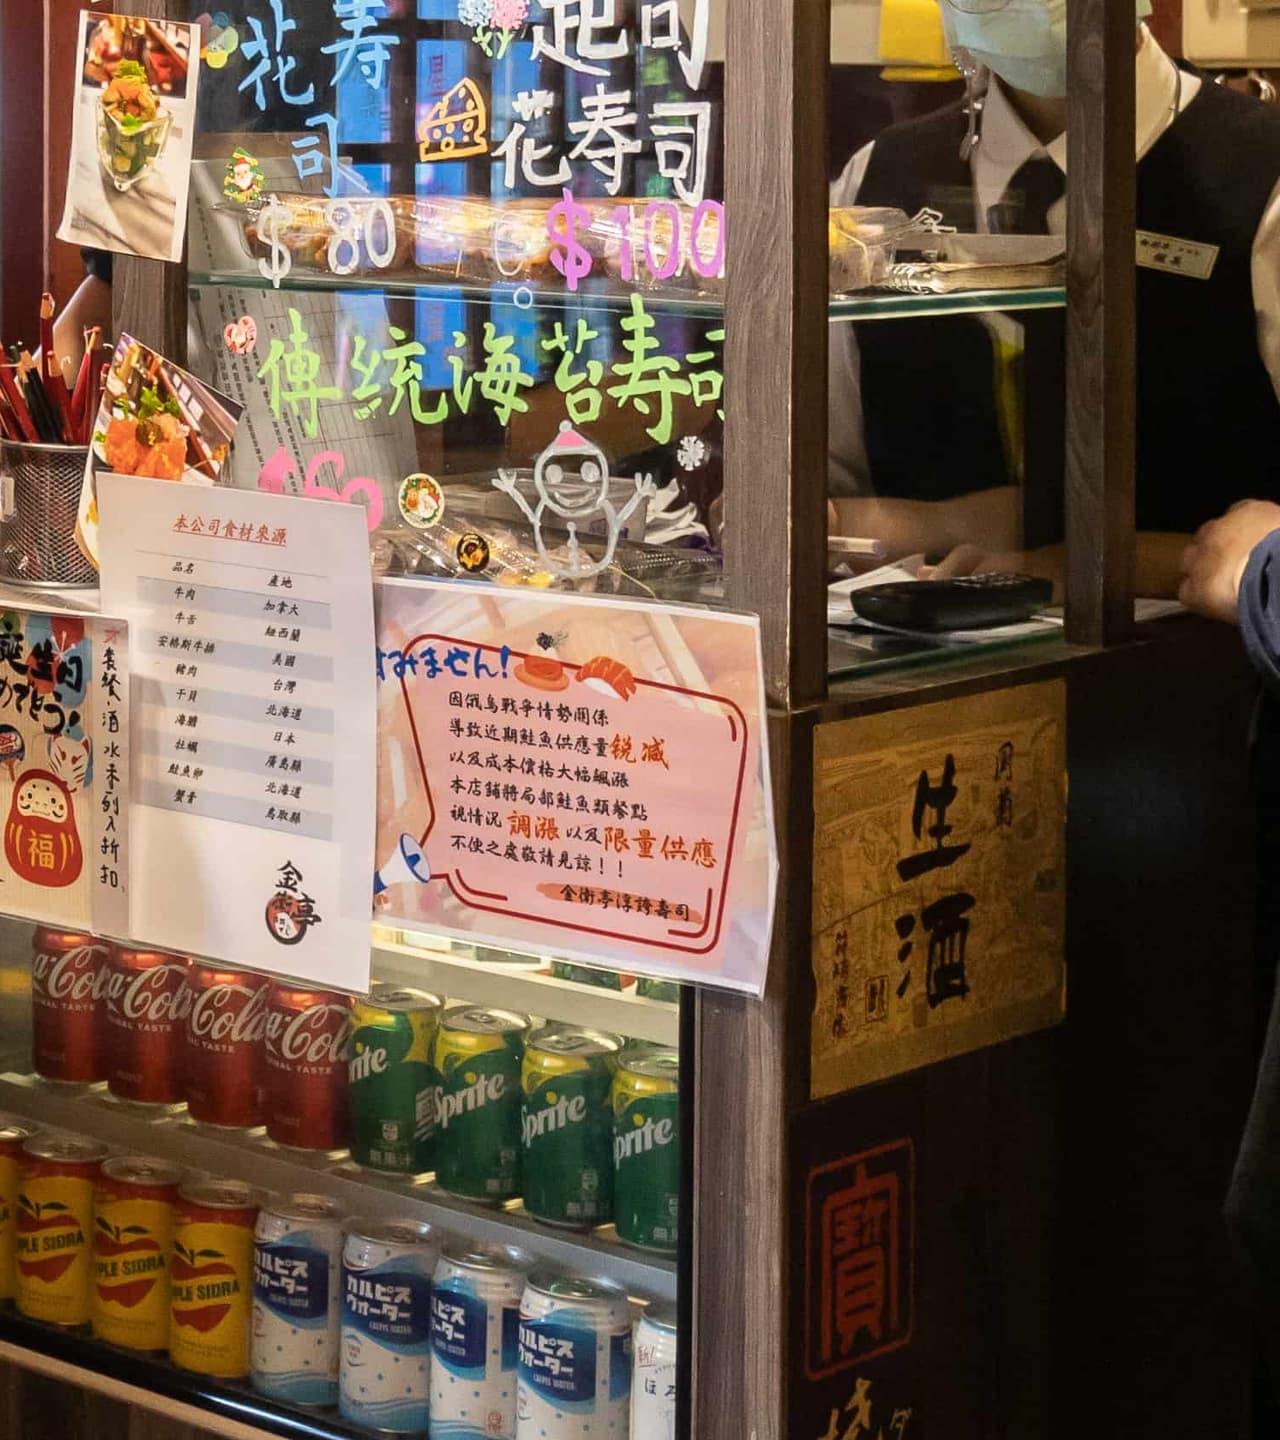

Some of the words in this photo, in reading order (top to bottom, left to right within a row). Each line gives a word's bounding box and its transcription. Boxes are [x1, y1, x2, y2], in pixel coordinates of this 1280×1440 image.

[173, 513, 287, 547] 本公司食材來源
[172, 561, 194, 575] 品名
[174, 586, 195, 600] 牛肉
[271, 654, 296, 668] 美國
[272, 678, 297, 694] 台灣
[265, 703, 302, 721] 北海道
[273, 731, 296, 745] 日本
[265, 781, 302, 799] 北海道
[27, 831, 55, 869] 福
[896, 753, 976, 1010] 生酒
[42, 1230, 85, 1251] SIDRA
[121, 1254, 165, 1274] SIDRA
[196, 1279, 240, 1301] SIDRA
[347, 1274, 412, 1304] カルピス
[346, 1293, 411, 1321] ウォーター
